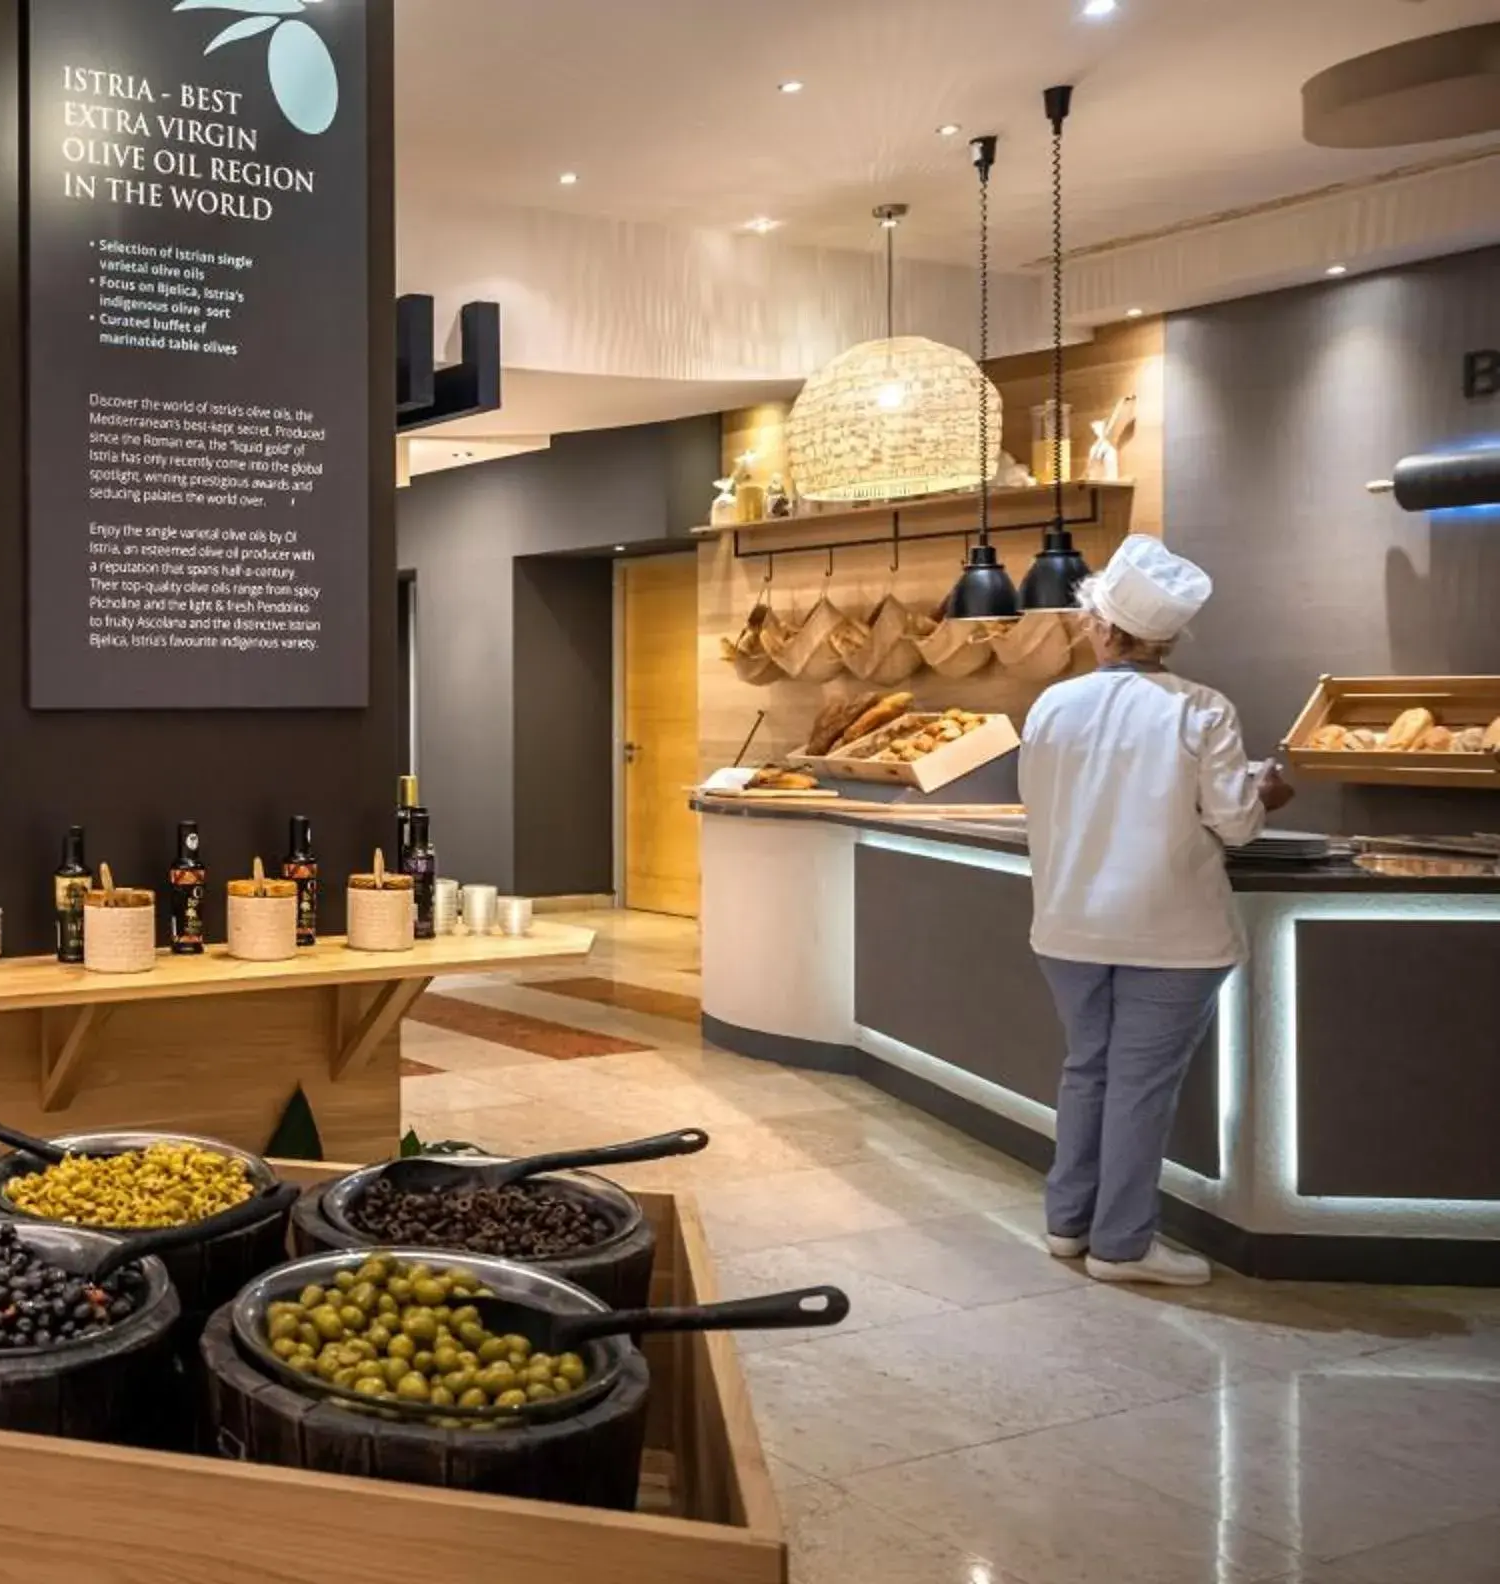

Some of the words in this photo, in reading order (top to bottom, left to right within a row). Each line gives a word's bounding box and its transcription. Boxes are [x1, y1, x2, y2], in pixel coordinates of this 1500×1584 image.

[64, 67, 156, 103] ISTRIA
[181, 84, 242, 115] BEST
[65, 103, 150, 137] EXTRA
[157, 115, 257, 151] VIRGIN
[62, 137, 145, 171] OLIVE
[154, 149, 202, 178] OIL
[211, 156, 314, 192] REGION
[65, 173, 95, 200] IN
[106, 178, 163, 208] THE
[170, 187, 272, 222] WORLD
[100, 240, 156, 257] Selection
[160, 248, 172, 259] of
[176, 249, 214, 263] Istrian
[218, 254, 252, 270] single
[100, 261, 148, 274] varietal
[152, 265, 180, 278] olive
[184, 268, 204, 280] oils
[100, 295, 168, 312] indigenous
[171, 303, 200, 315] olive
[206, 308, 231, 318] sort
[100, 314, 150, 329] Curated
[154, 319, 190, 332] buffet
[194, 323, 207, 334] of
[100, 334, 165, 348] marinated
[169, 339, 200, 351] table
[203, 342, 238, 355] olives
